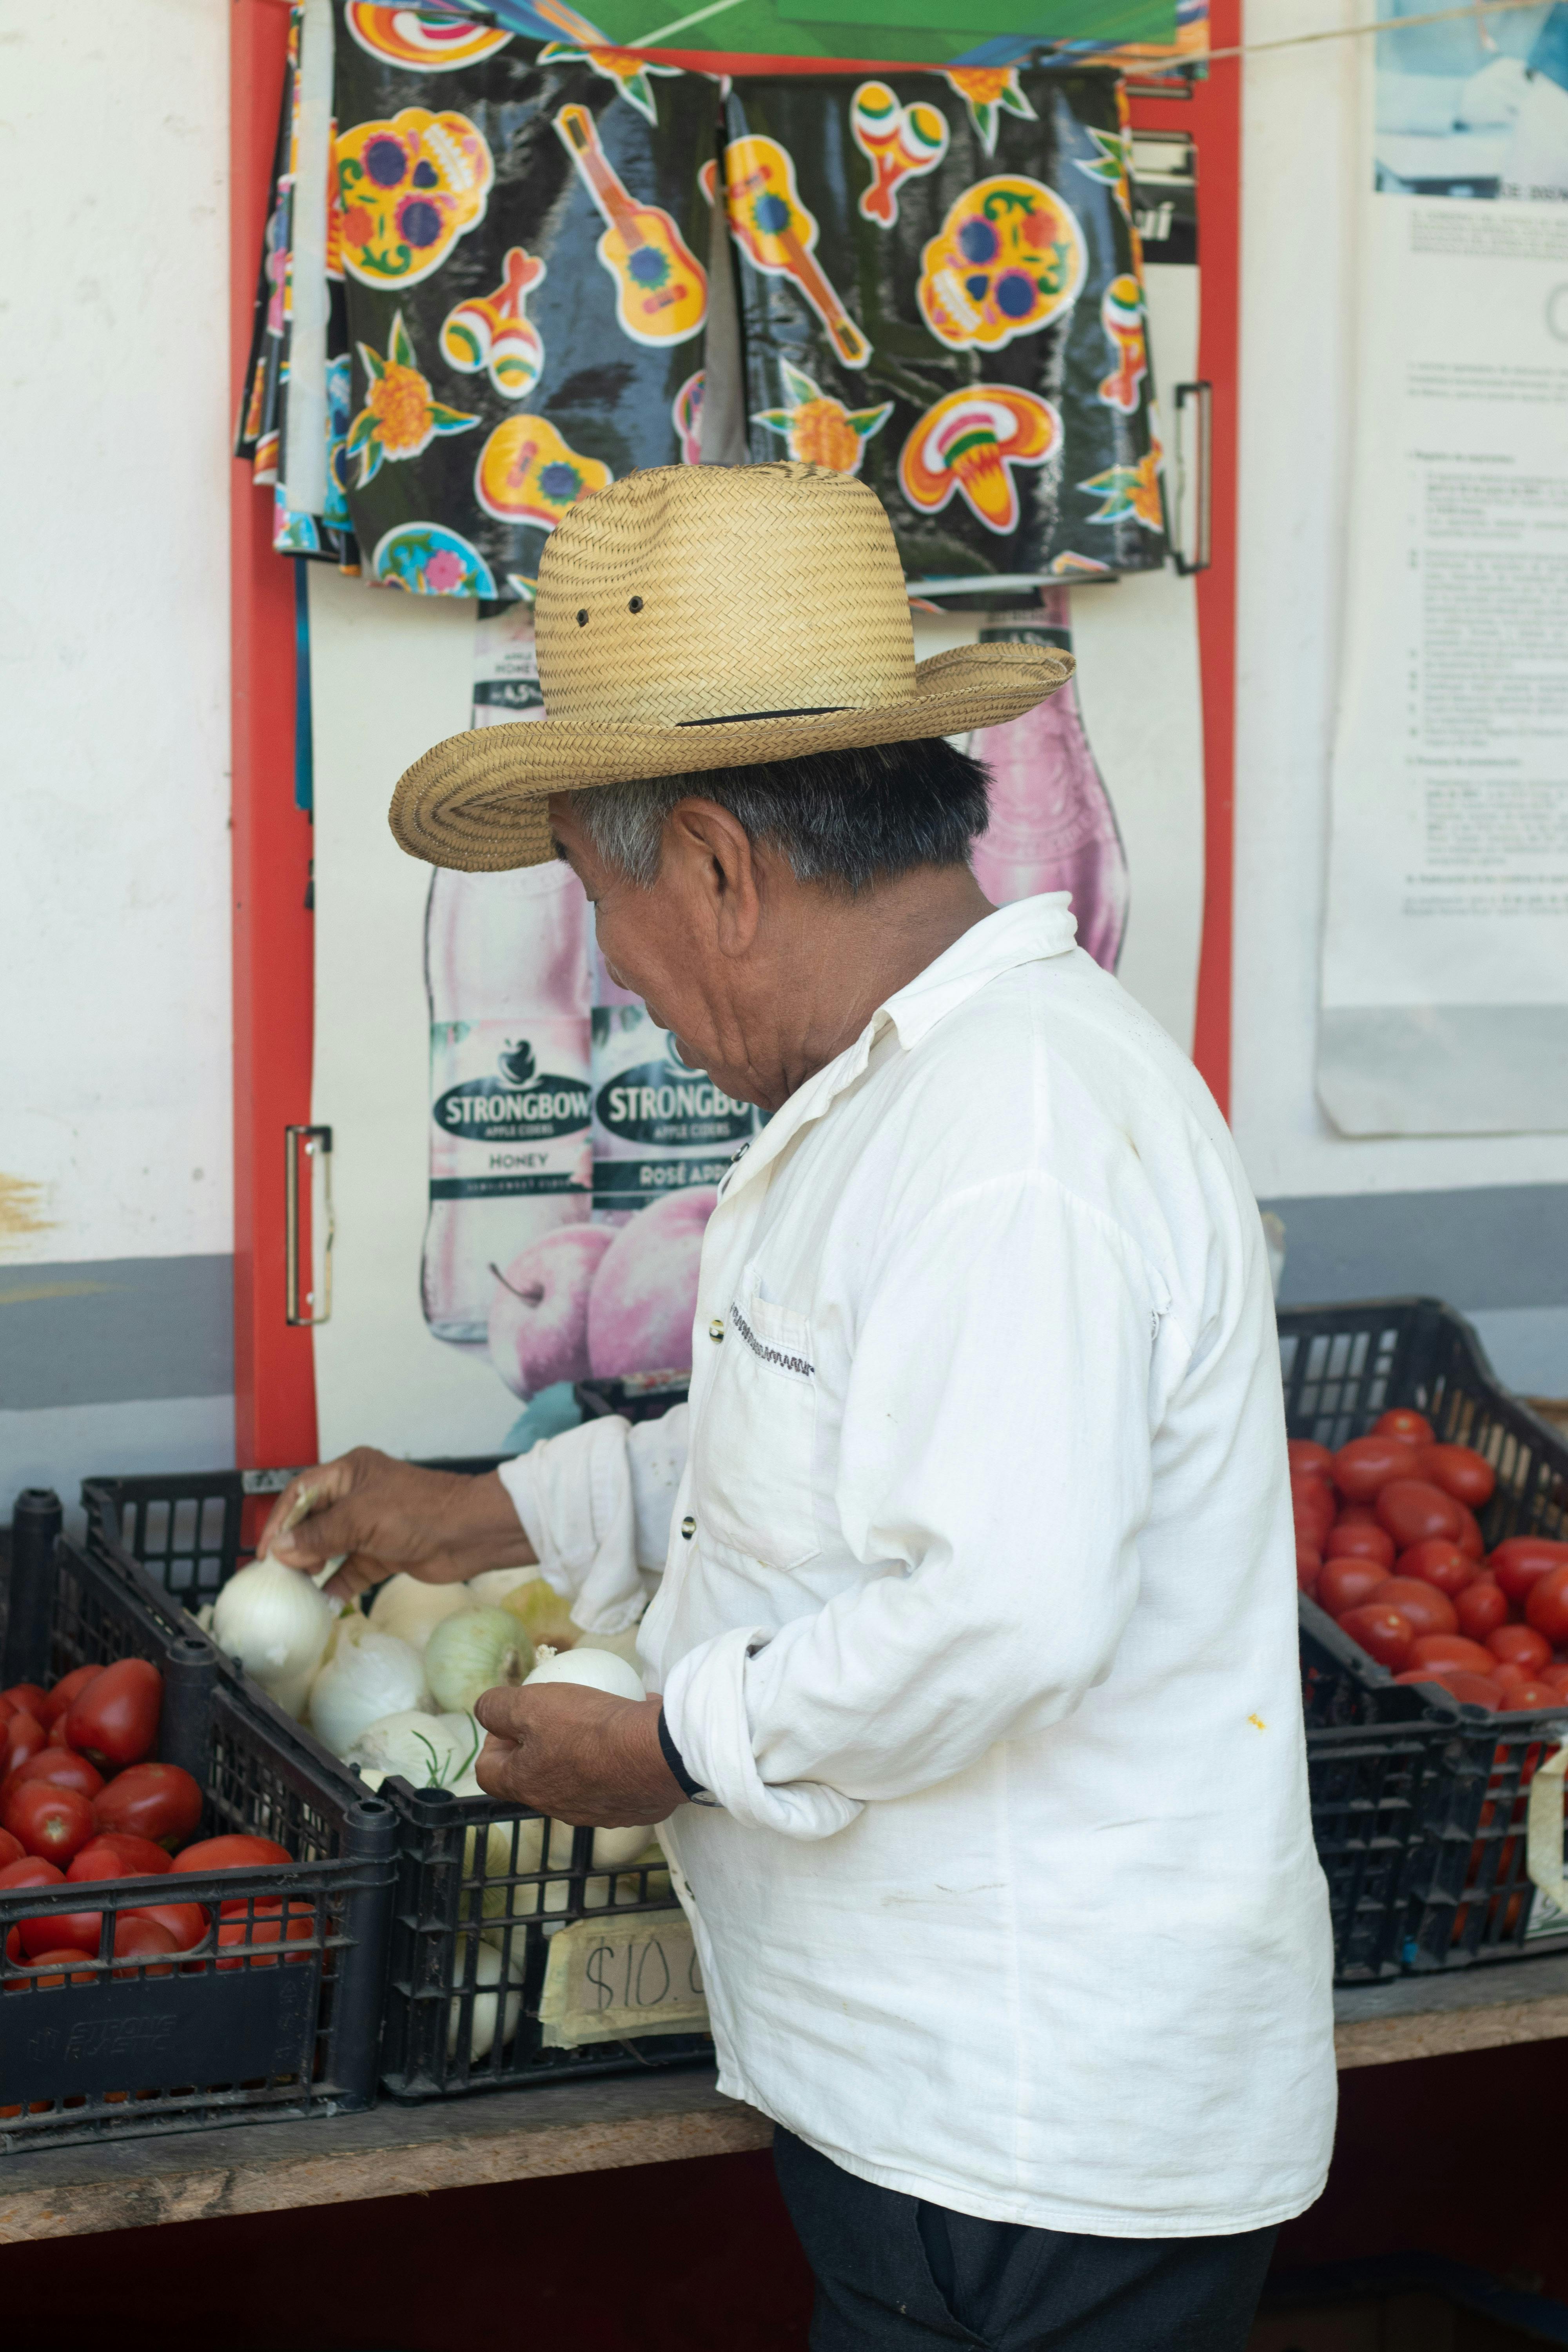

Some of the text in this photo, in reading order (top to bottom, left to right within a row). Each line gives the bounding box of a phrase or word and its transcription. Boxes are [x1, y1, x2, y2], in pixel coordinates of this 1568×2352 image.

[445, 1091, 588, 1125] STRONGBOW
[489, 1152, 548, 1169] HONEY
[639, 1162, 729, 1186] ROSÉ APP
